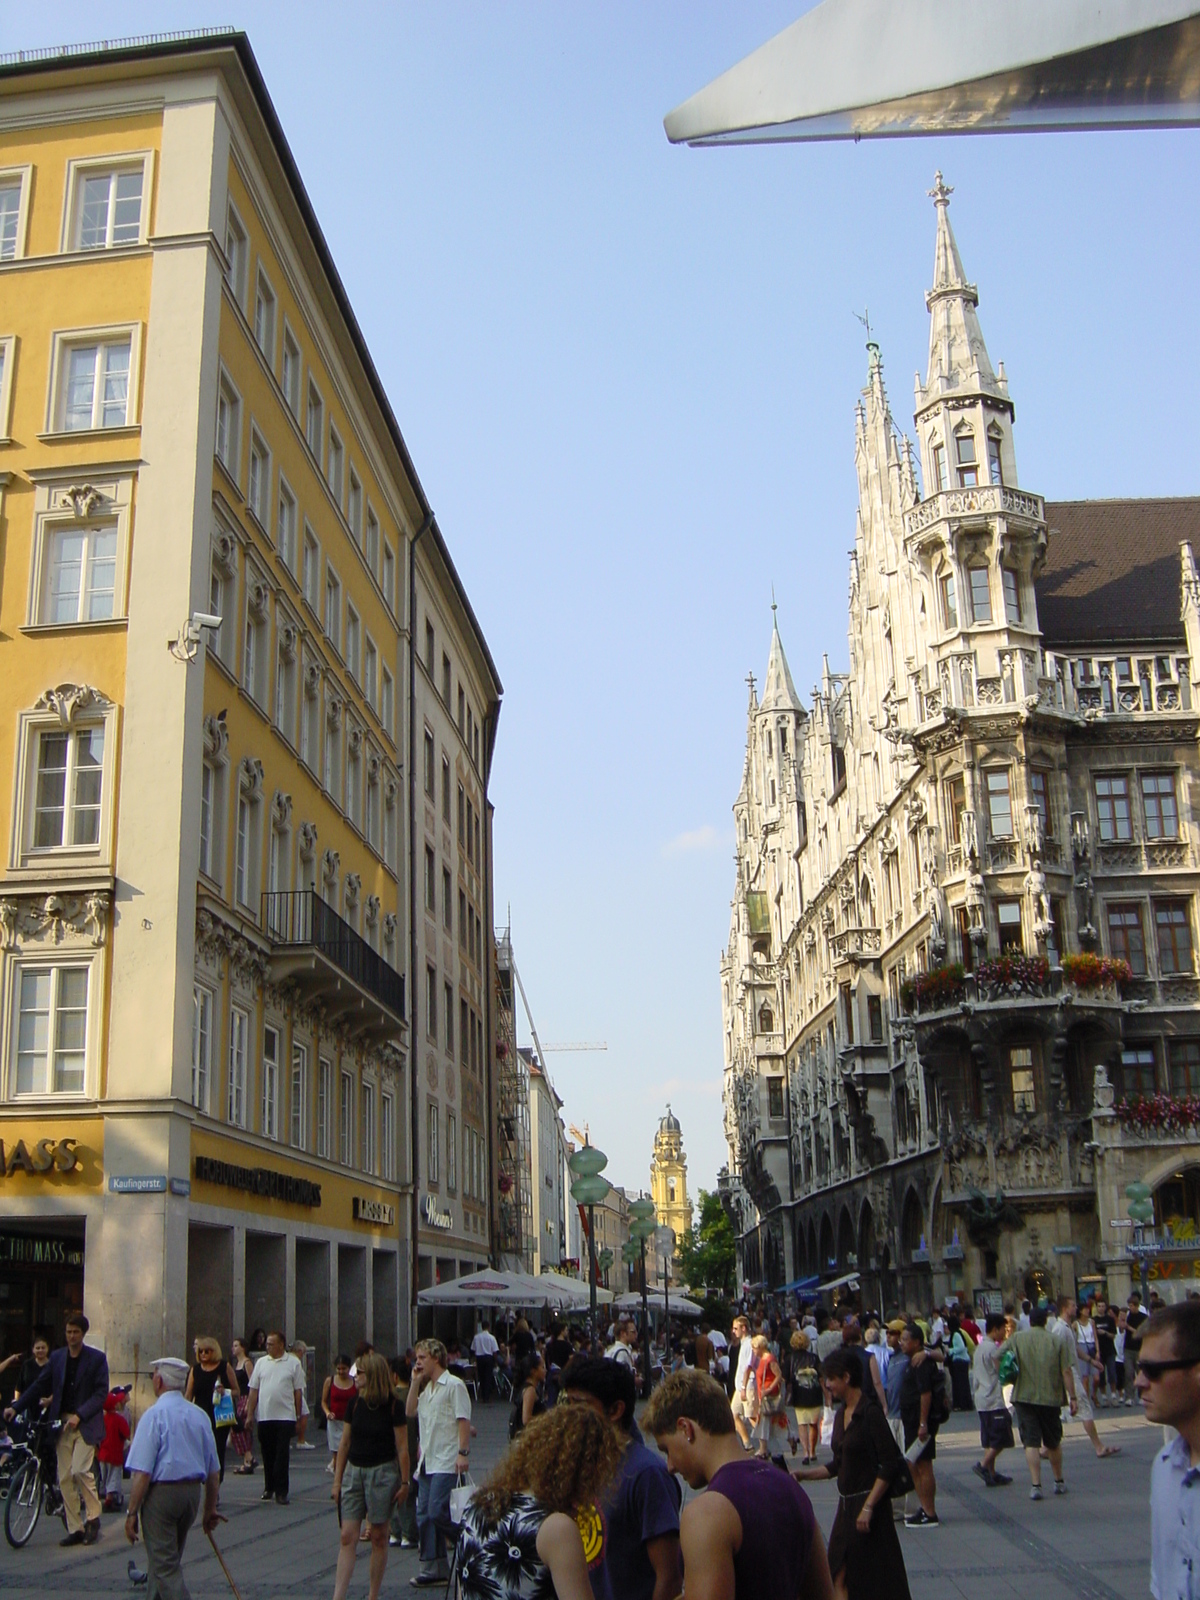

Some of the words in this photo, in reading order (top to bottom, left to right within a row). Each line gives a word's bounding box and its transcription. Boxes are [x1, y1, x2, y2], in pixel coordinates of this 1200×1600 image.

[0, 1138, 77, 1177] ASS
[113, 1178, 161, 1190] Kaufingerstr.
[10, 1237, 65, 1263] THOMASS
